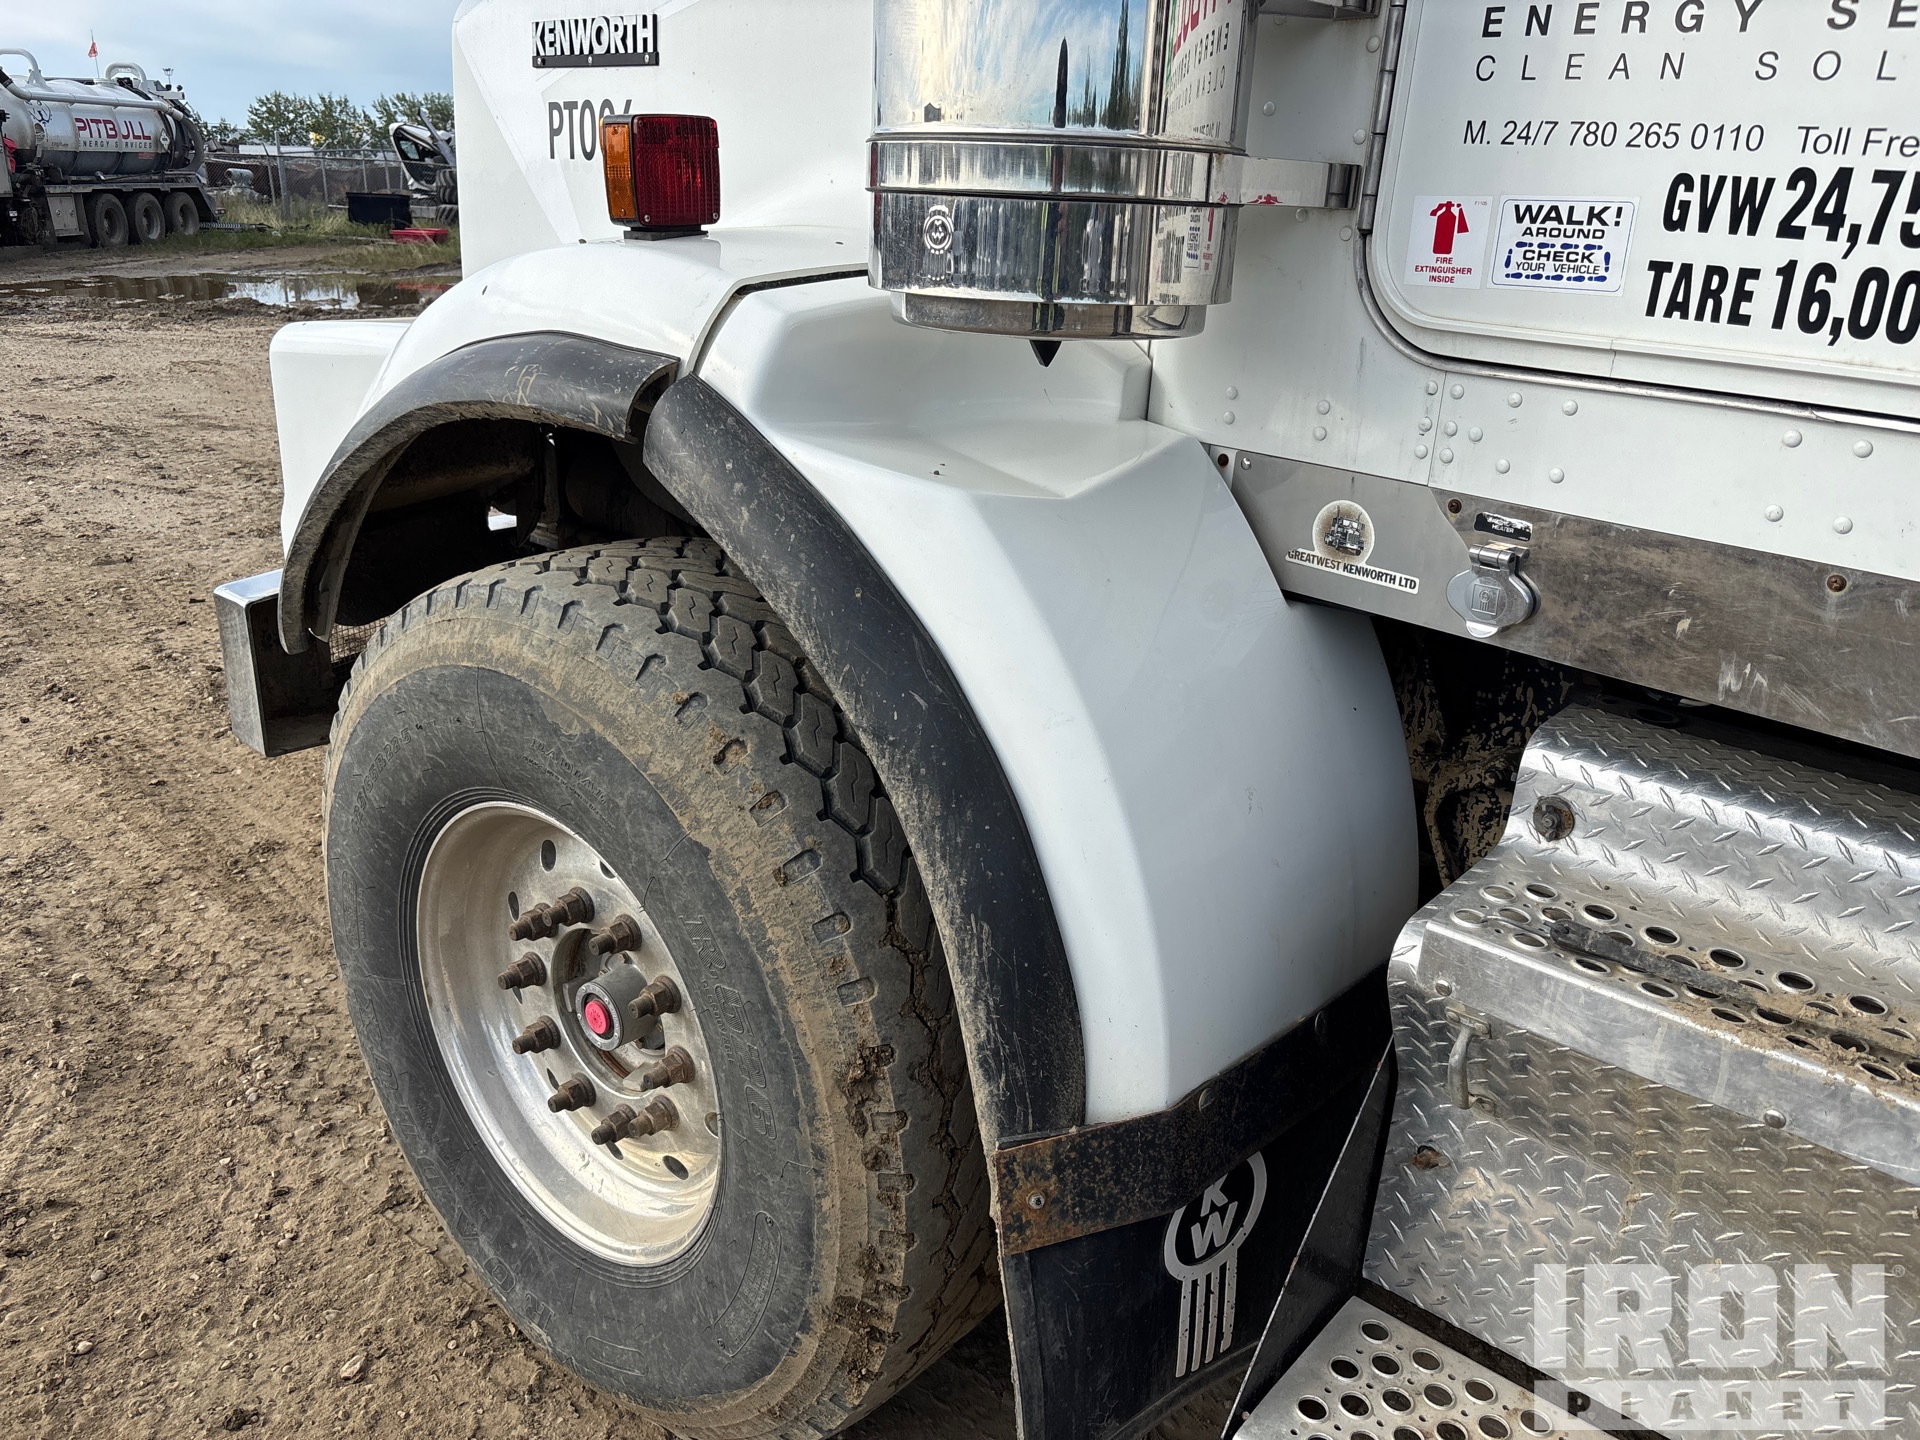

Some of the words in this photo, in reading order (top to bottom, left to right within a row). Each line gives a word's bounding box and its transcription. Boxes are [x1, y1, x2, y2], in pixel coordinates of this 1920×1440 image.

[532, 14, 656, 56] KENWORTH
[1481, 0, 1763, 38] ENERGY
[1827, 0, 1919, 30] SE
[1475, 51, 1685, 82] CLEAN
[1755, 50, 1897, 81] SOL
[548, 98, 633, 161] PT0
[1463, 120, 1491, 145] M.
[1500, 120, 1559, 146] 24/7
[1569, 121, 1617, 147] 780
[1625, 121, 1681, 149] 265
[1690, 123, 1764, 151] 0110
[1798, 126, 1851, 155] Toll
[1862, 128, 1919, 157] Fre
[1514, 204, 1623, 227] WALK!
[1663, 172, 1776, 237] GVW
[1521, 227, 1605, 240] AROUND
[1414, 265, 1472, 275] EXTINGUISHER
[1435, 257, 1453, 265] FIRE
[1516, 261, 1546, 272] YOUR
[1553, 263, 1600, 275] VEHICLE
[1523, 249, 1595, 264] CHECK
[1428, 275, 1455, 284] INSIDE
[1645, 259, 1761, 327] TARE
[1771, 259, 1919, 346] 16,00
[1287, 549, 1342, 571] GREATWEST
[1342, 564, 1396, 585] KENWORTH
[1398, 576, 1417, 590] LTD
